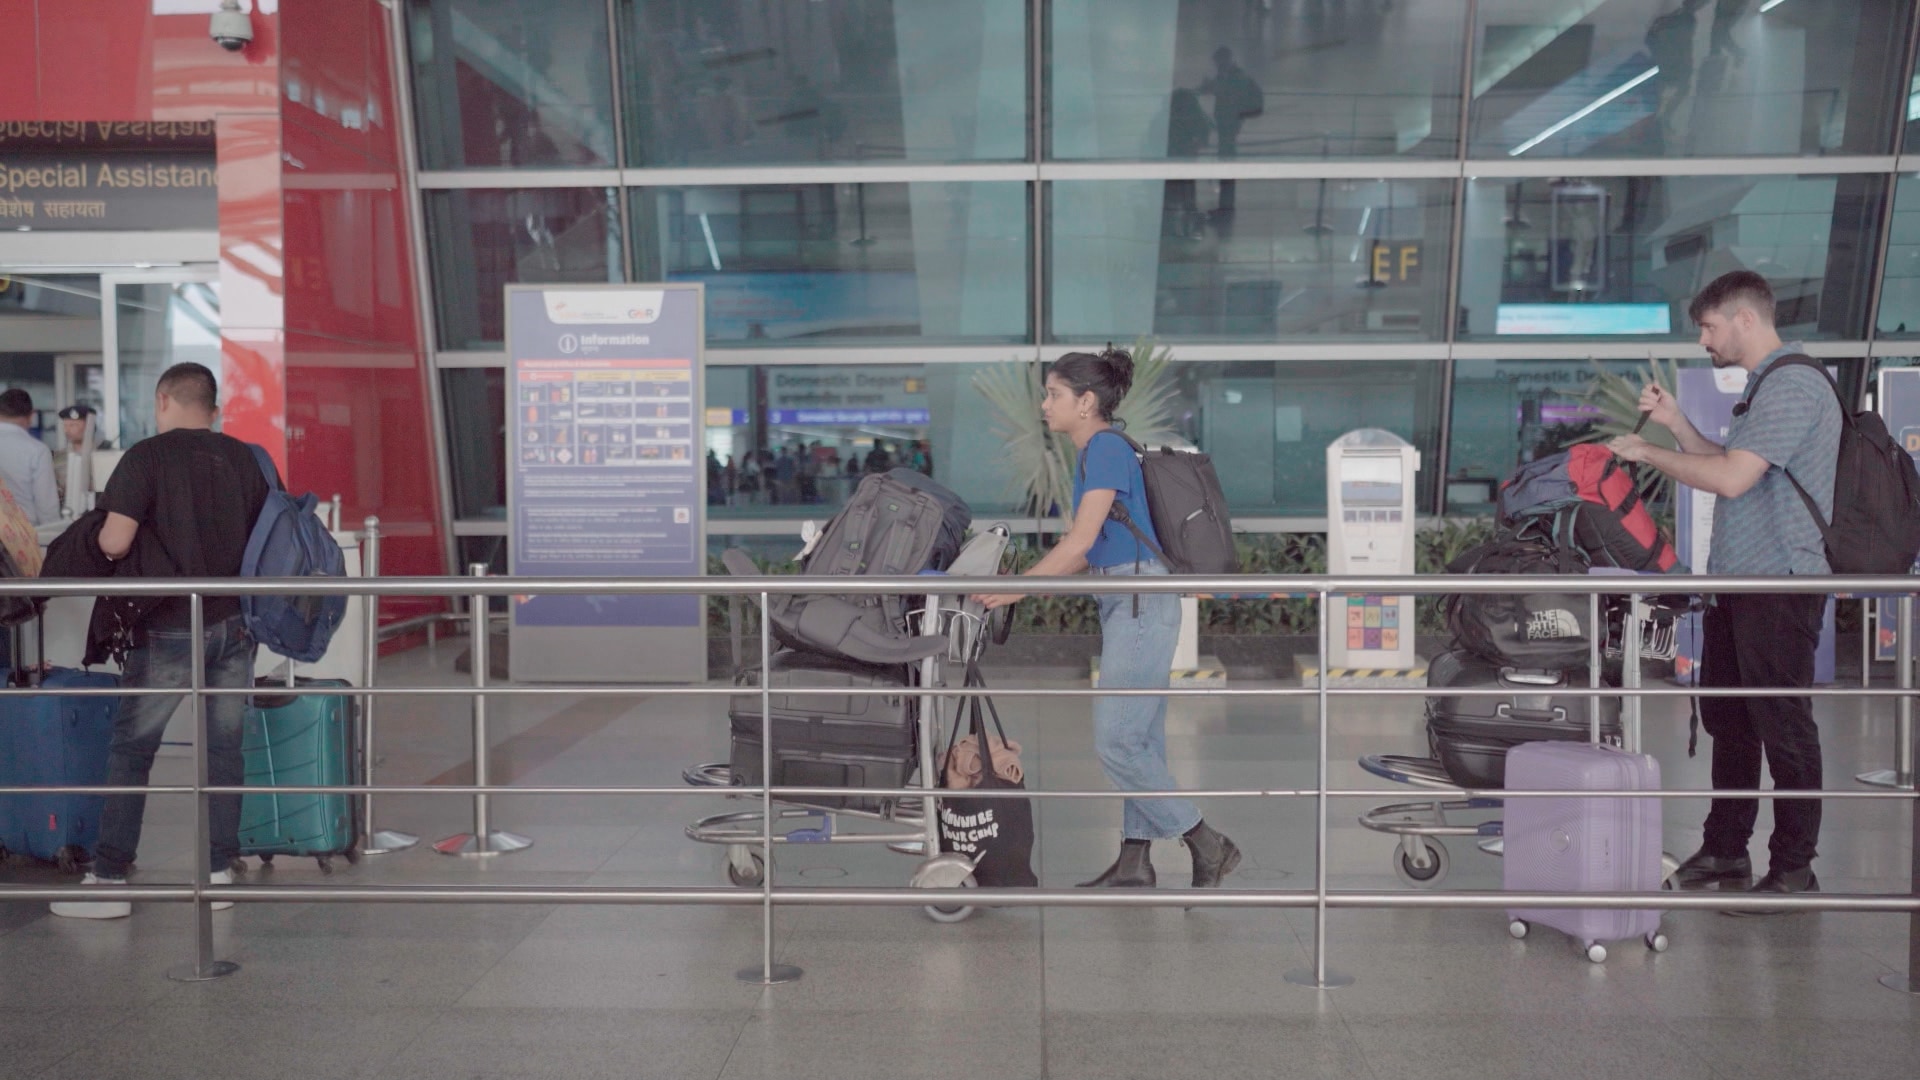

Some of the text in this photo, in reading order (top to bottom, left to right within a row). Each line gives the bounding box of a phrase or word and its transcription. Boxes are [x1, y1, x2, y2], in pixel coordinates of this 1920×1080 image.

[44, 200, 106, 218] सहायता
[581, 334, 650, 346] Information
[1532, 609, 1557, 622] THE
[1527, 630, 1559, 640] FACE
[977, 809, 993, 825] BE
[942, 822, 968, 842] YOUR
[952, 841, 977, 852] DOG
